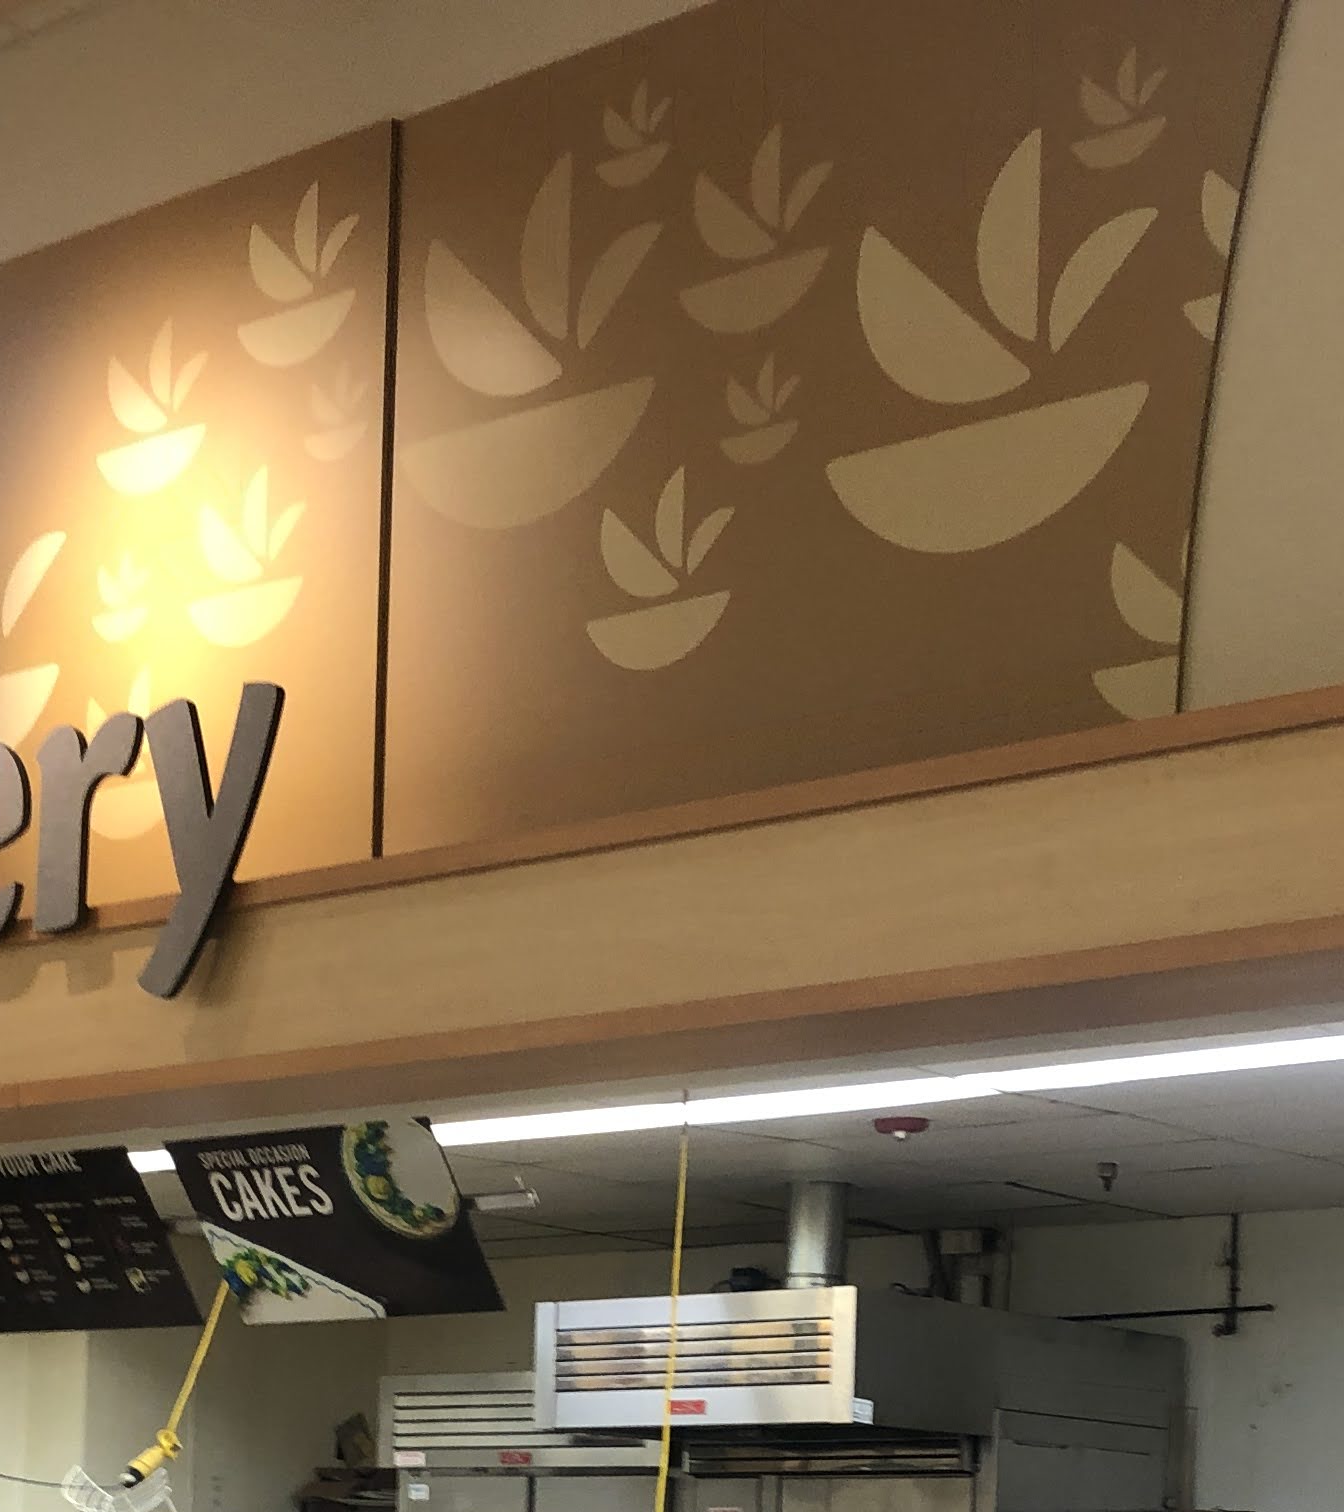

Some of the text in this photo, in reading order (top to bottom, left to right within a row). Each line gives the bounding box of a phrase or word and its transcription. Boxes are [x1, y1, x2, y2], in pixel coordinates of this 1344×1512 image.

[198, 1143, 312, 1169] SPECIAL OCCASION
[209, 1165, 335, 1222] CAKES
